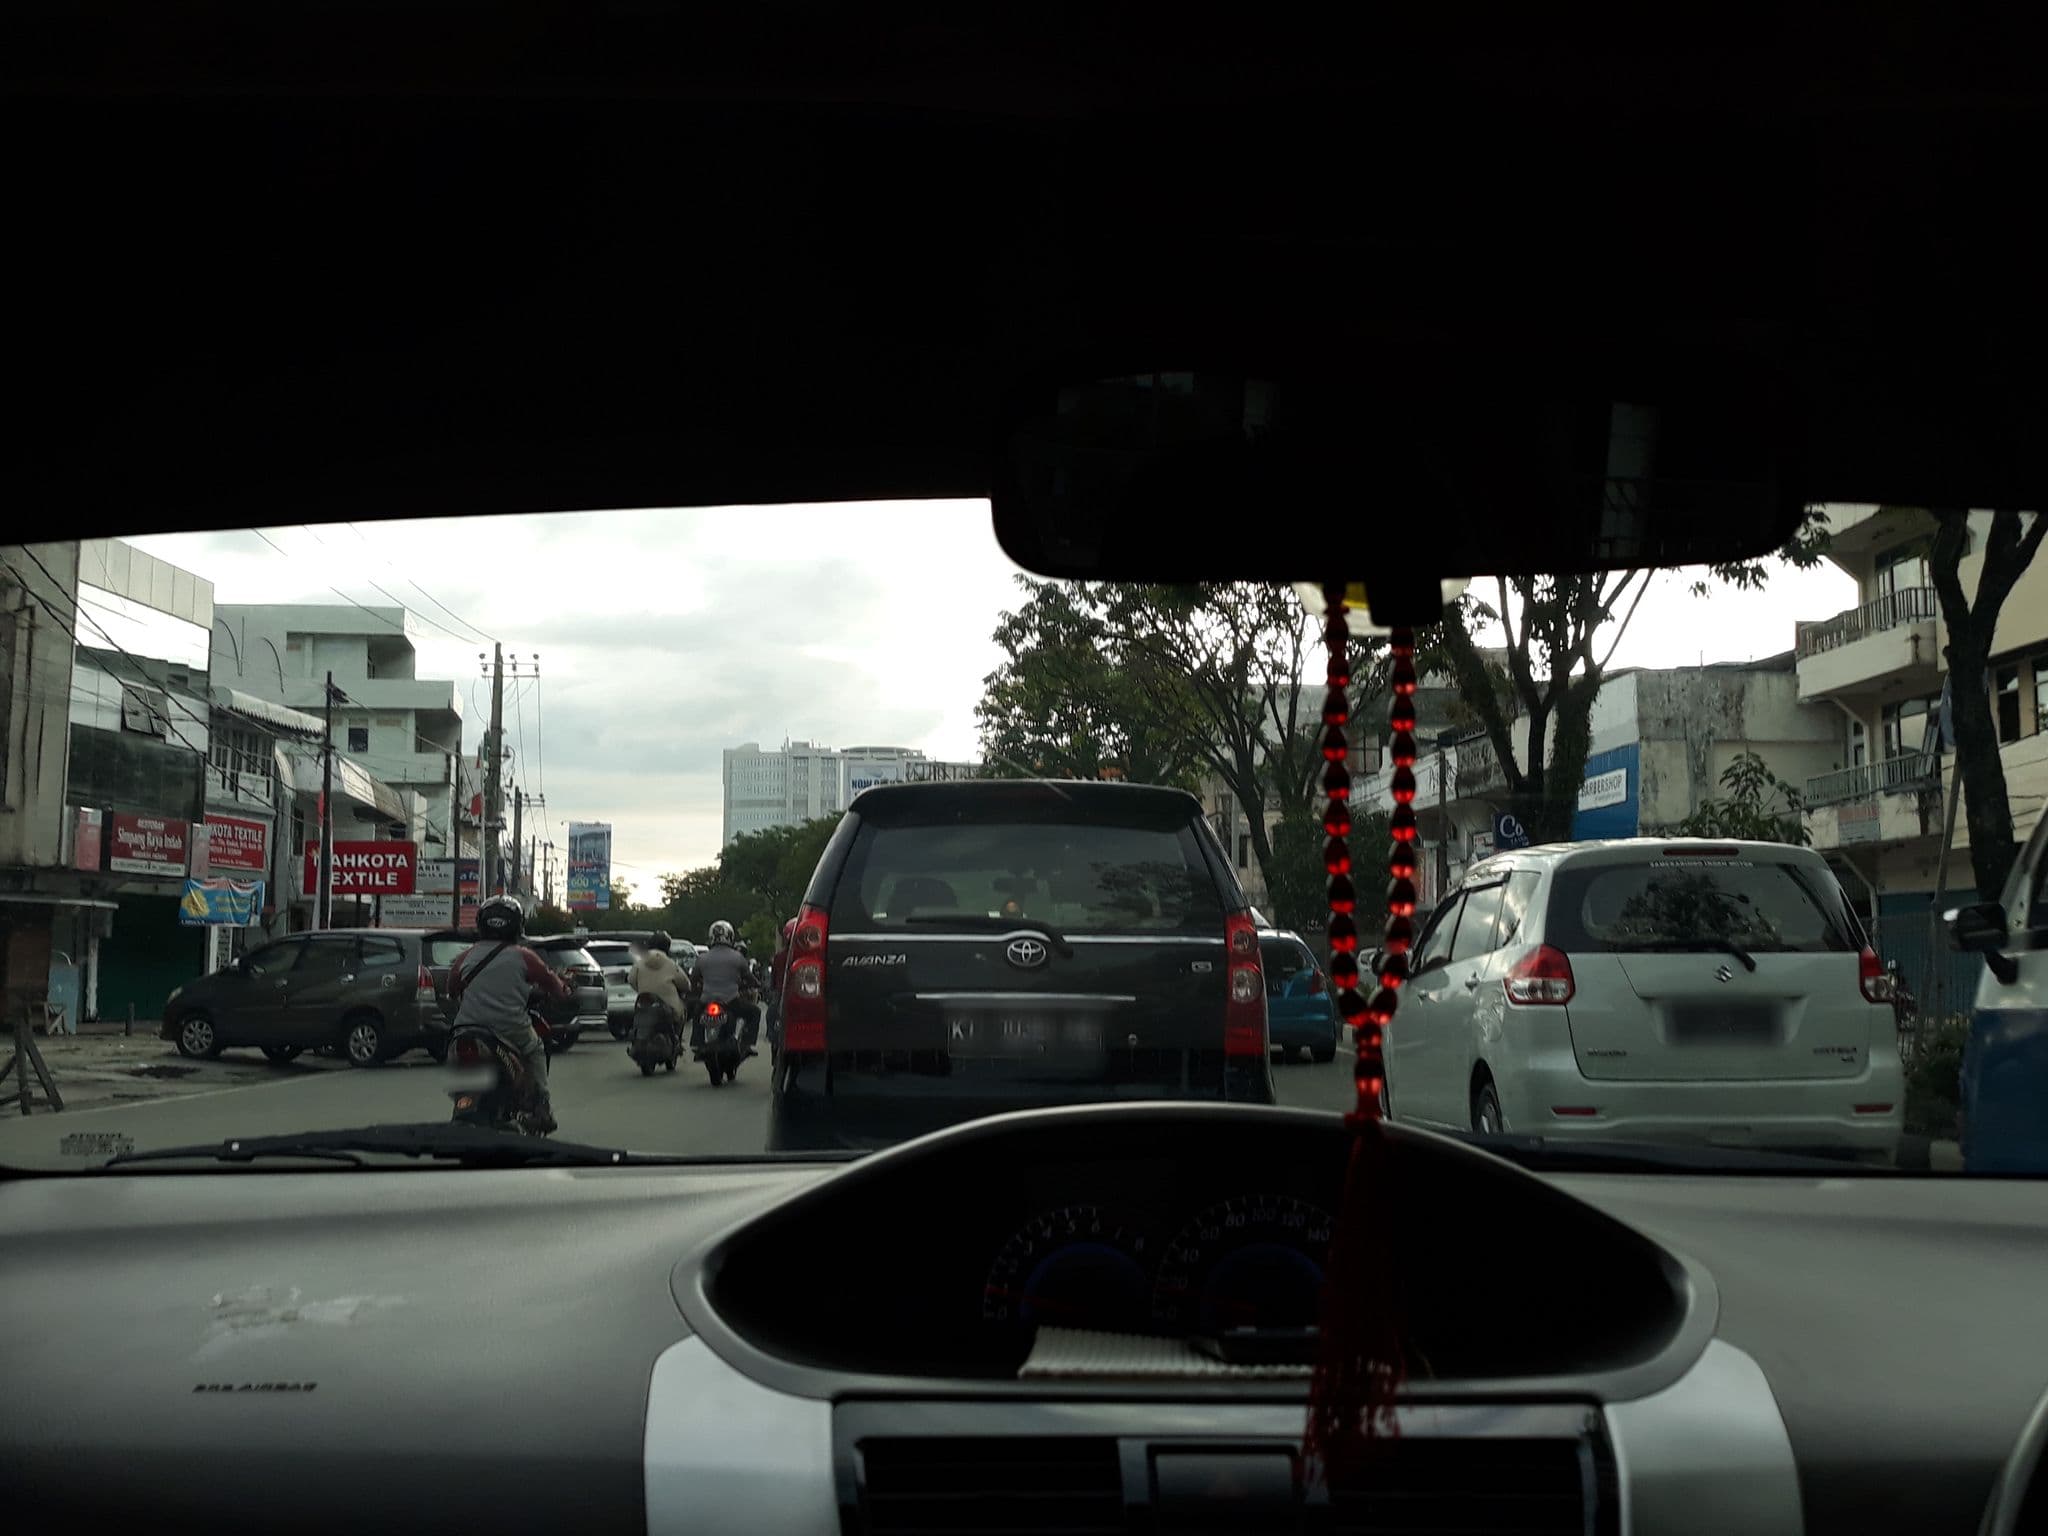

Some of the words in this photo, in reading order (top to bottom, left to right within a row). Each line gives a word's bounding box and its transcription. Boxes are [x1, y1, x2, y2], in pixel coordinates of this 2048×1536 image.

[118, 826, 145, 850] Simpang
[146, 831, 163, 851] Raya
[233, 826, 263, 844] TEXTILE
[331, 871, 398, 886] EXTILE
[842, 954, 907, 967] AVANZA
